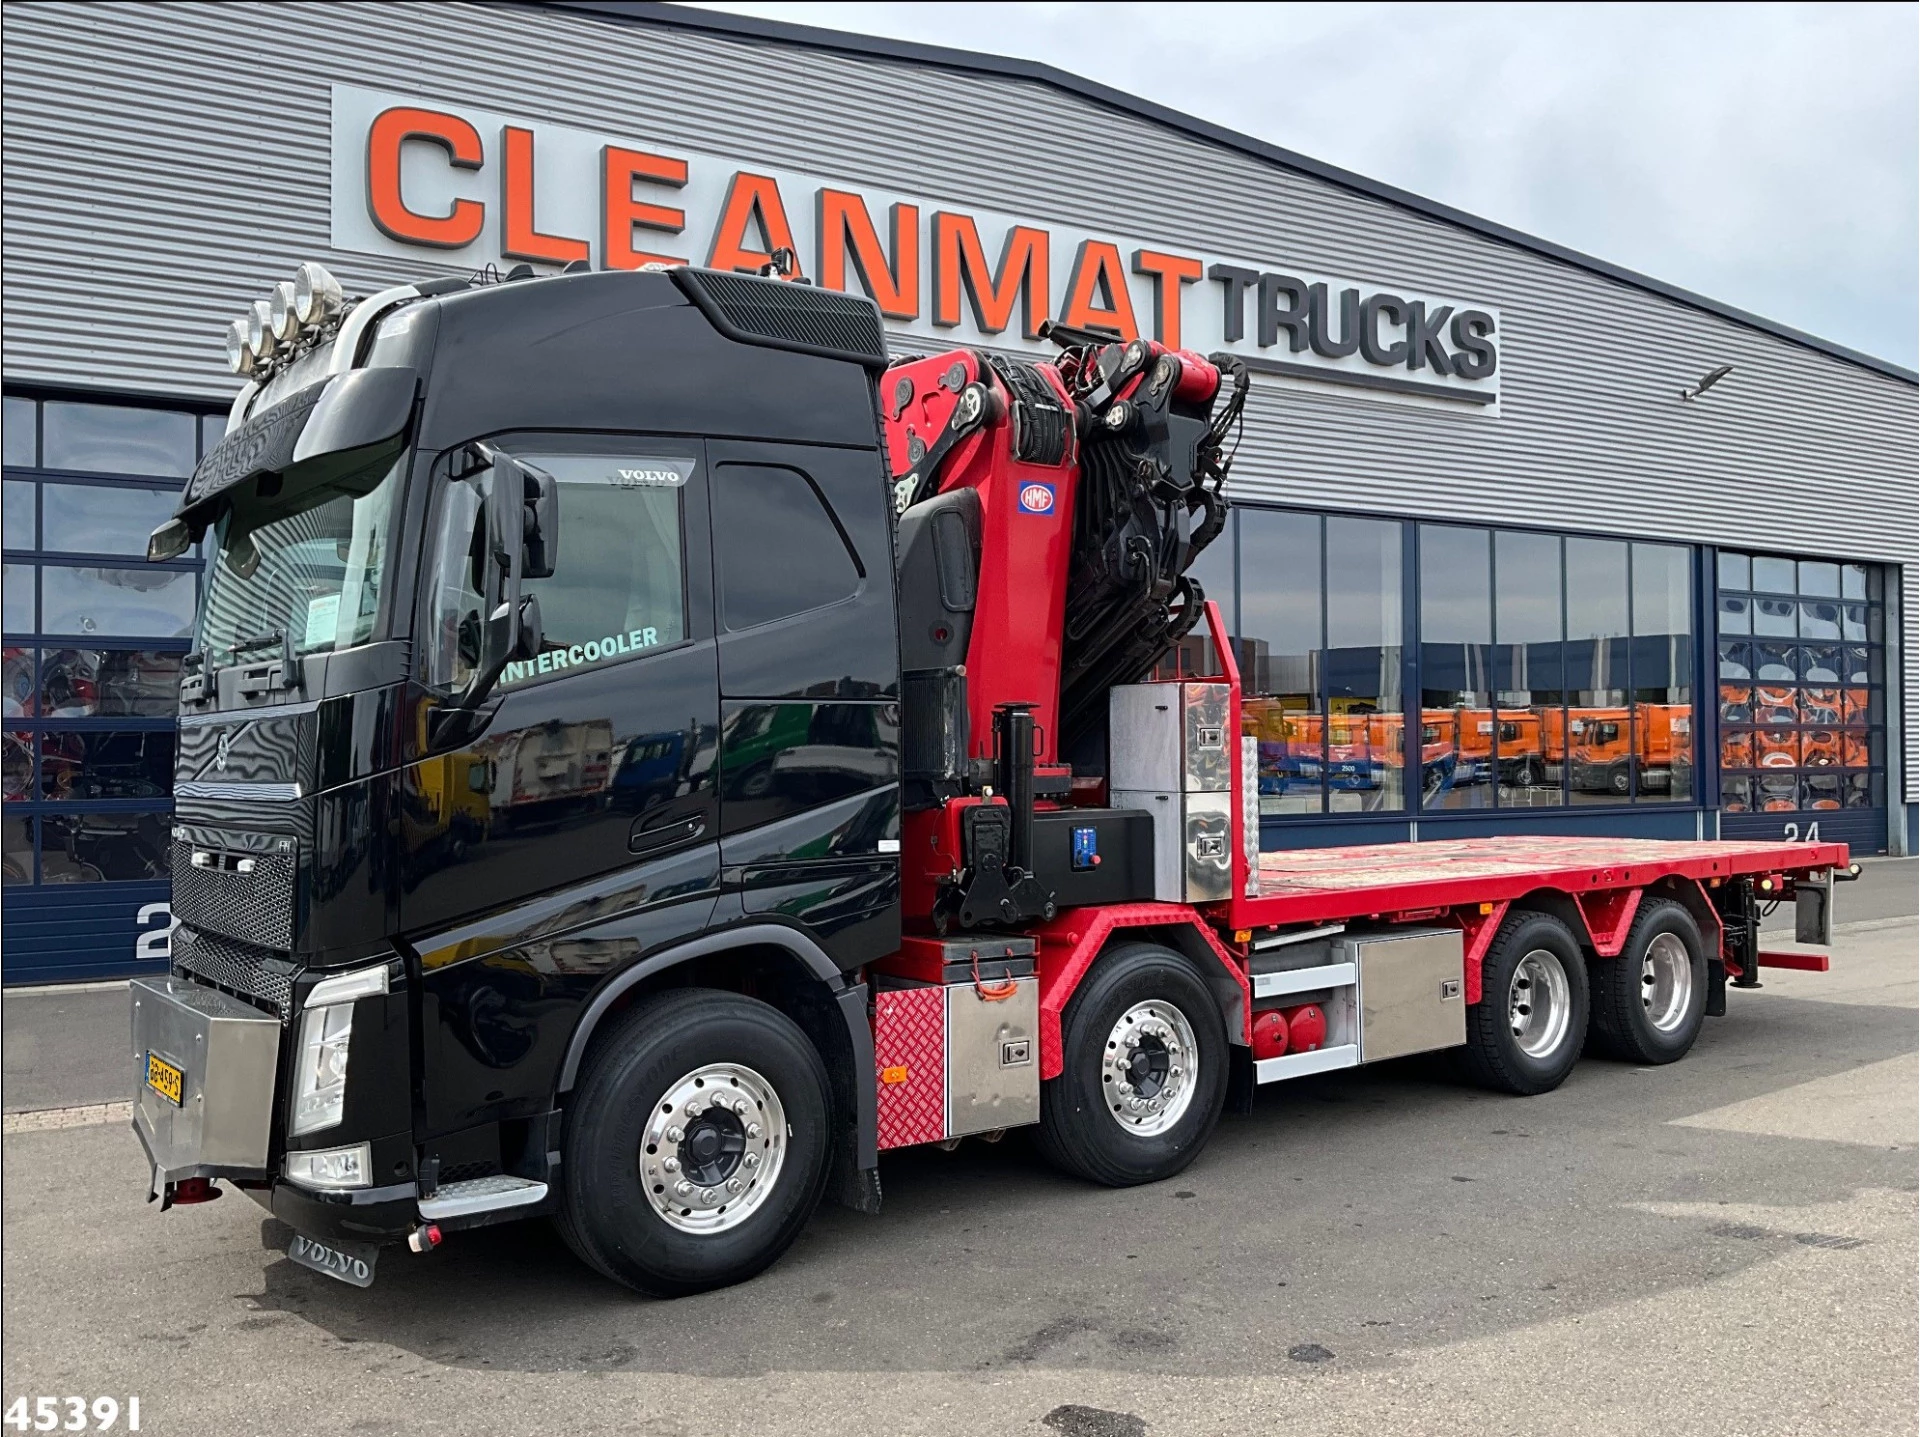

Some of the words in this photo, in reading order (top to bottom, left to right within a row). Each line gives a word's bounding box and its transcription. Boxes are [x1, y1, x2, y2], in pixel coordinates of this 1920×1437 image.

[366, 106, 1203, 351] CLEANMAT
[1208, 262, 1497, 380] TRUCKS
[617, 468, 679, 482] VOLVO
[1025, 488, 1049, 508] HMF
[296, 1234, 369, 1279] VOLVO
